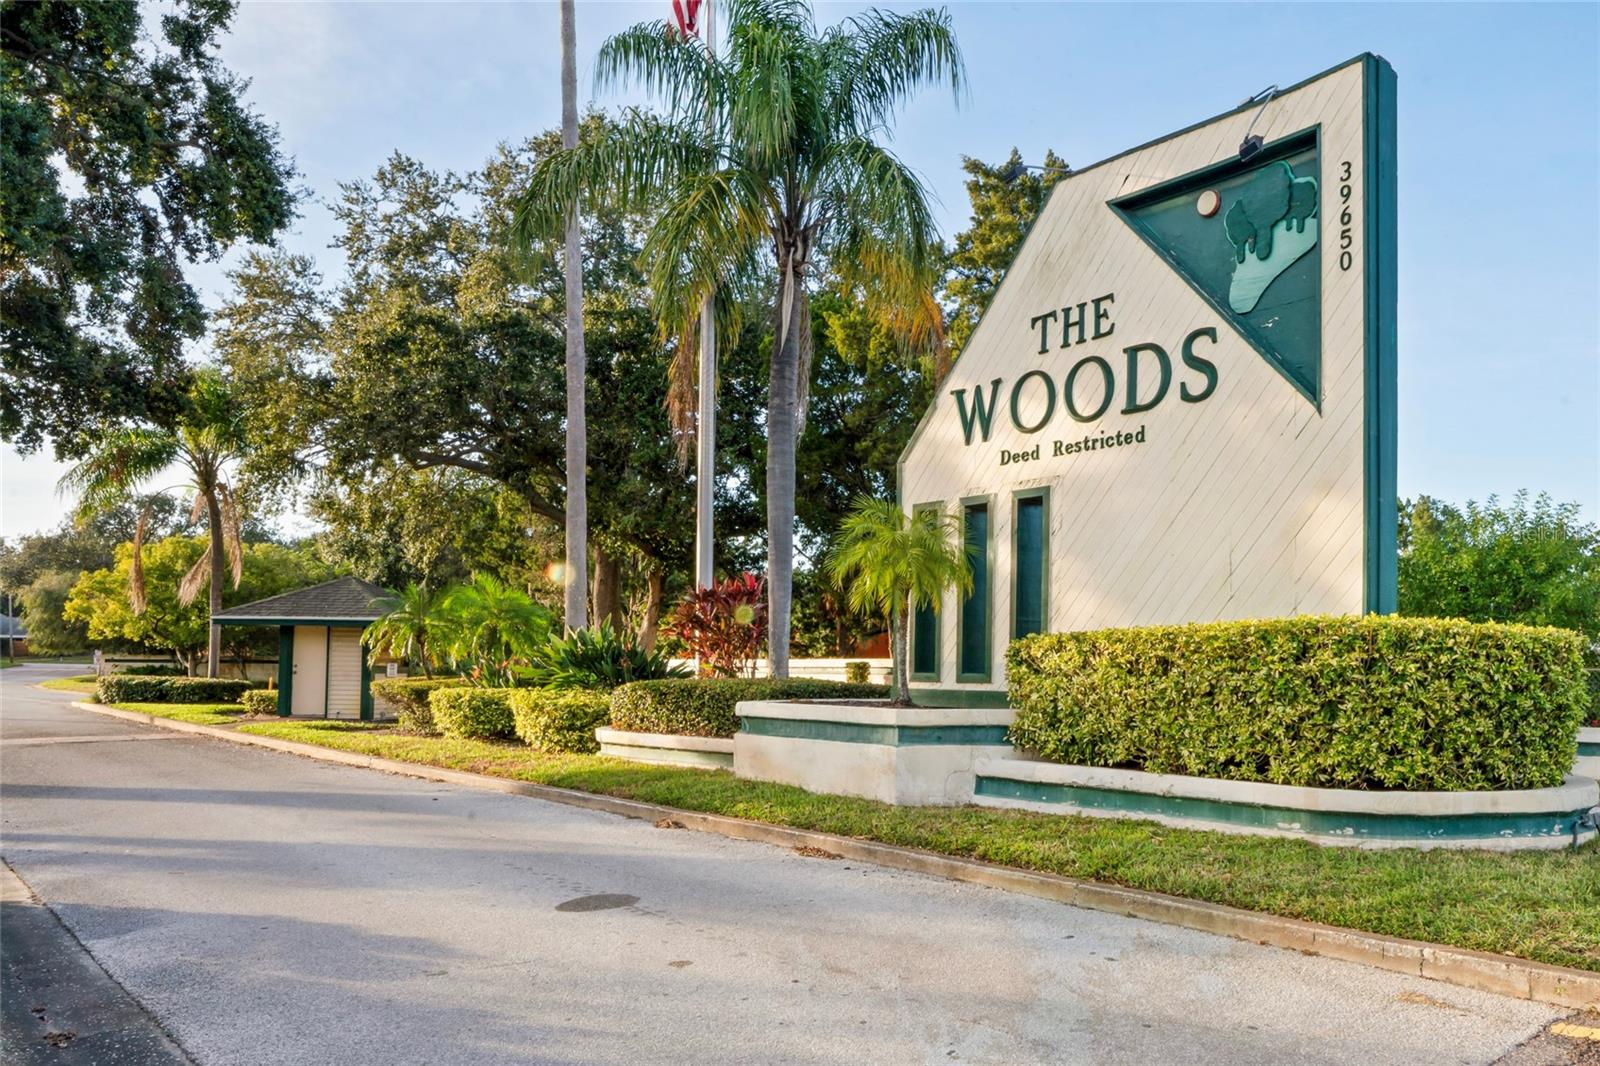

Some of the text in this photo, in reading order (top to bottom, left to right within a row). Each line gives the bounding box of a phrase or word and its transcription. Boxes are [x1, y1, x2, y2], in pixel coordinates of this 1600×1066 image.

[1340, 161, 1352, 271] 39650
[1030, 292, 1116, 355] THE
[950, 327, 1219, 446] WOODS
[1000, 425, 1146, 466] Deed Restricted
